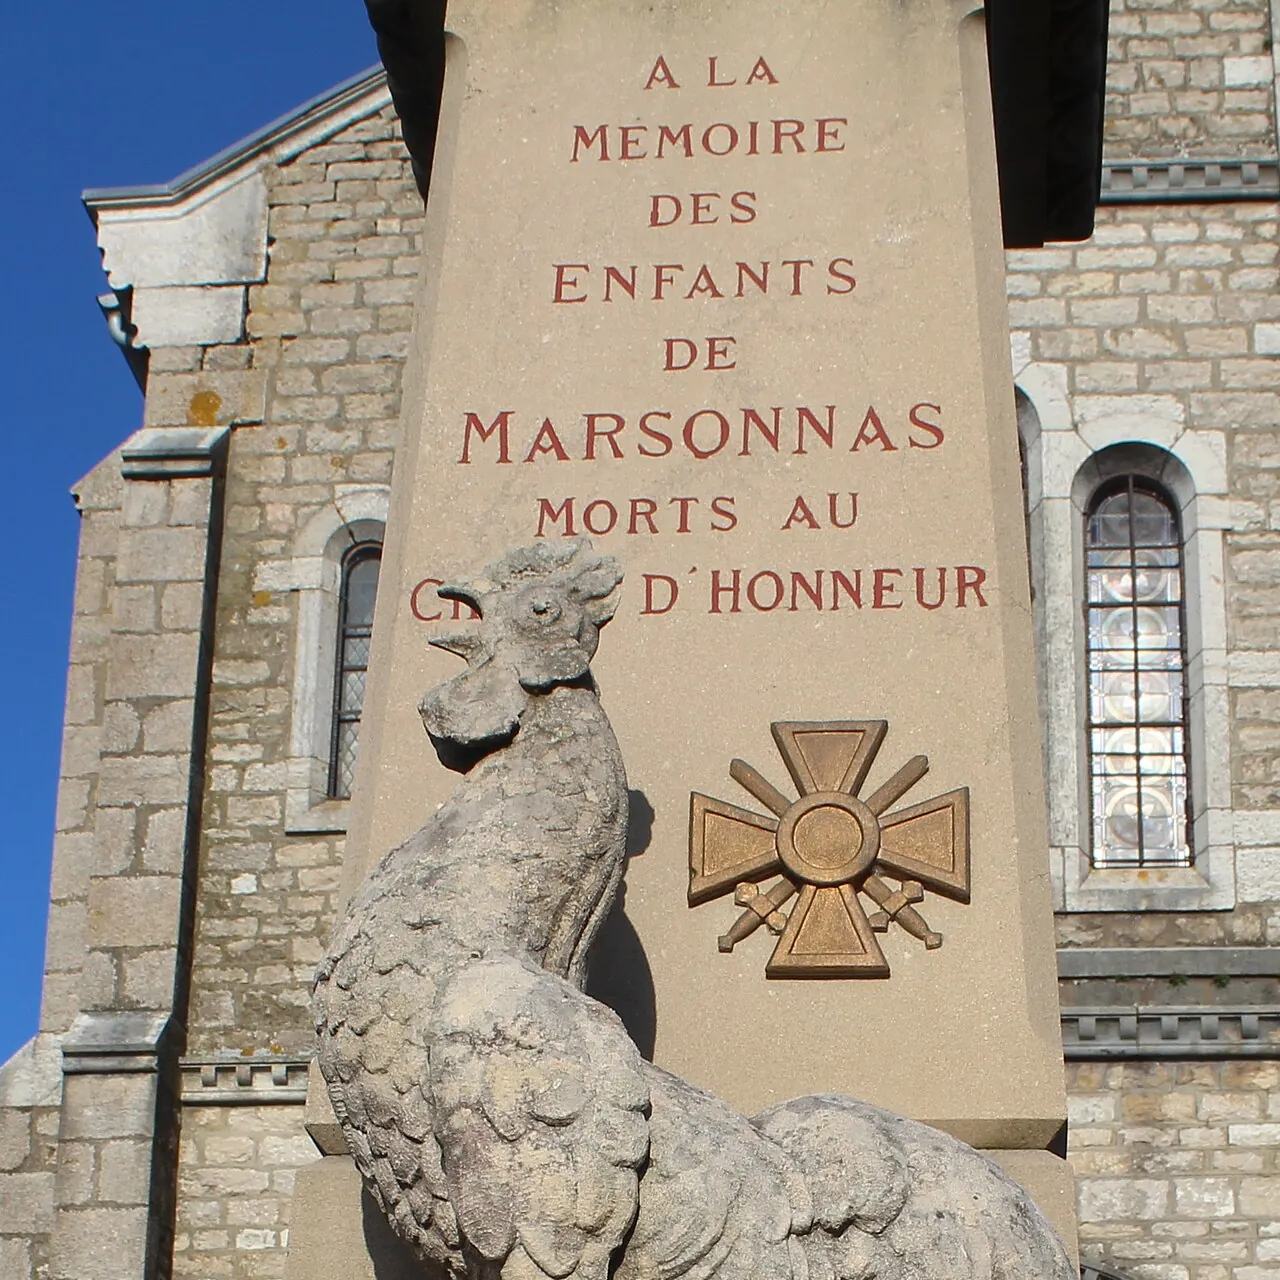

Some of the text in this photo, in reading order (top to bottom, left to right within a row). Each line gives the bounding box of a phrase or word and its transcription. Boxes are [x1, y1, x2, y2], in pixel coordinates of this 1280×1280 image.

[643, 55, 779, 90] A LA
[648, 190, 758, 228] DES
[552, 257, 858, 304] ENFANTS
[663, 335, 738, 372] DE
[457, 402, 947, 465] MARSONNAS
[533, 492, 860, 538] MORTS AU
